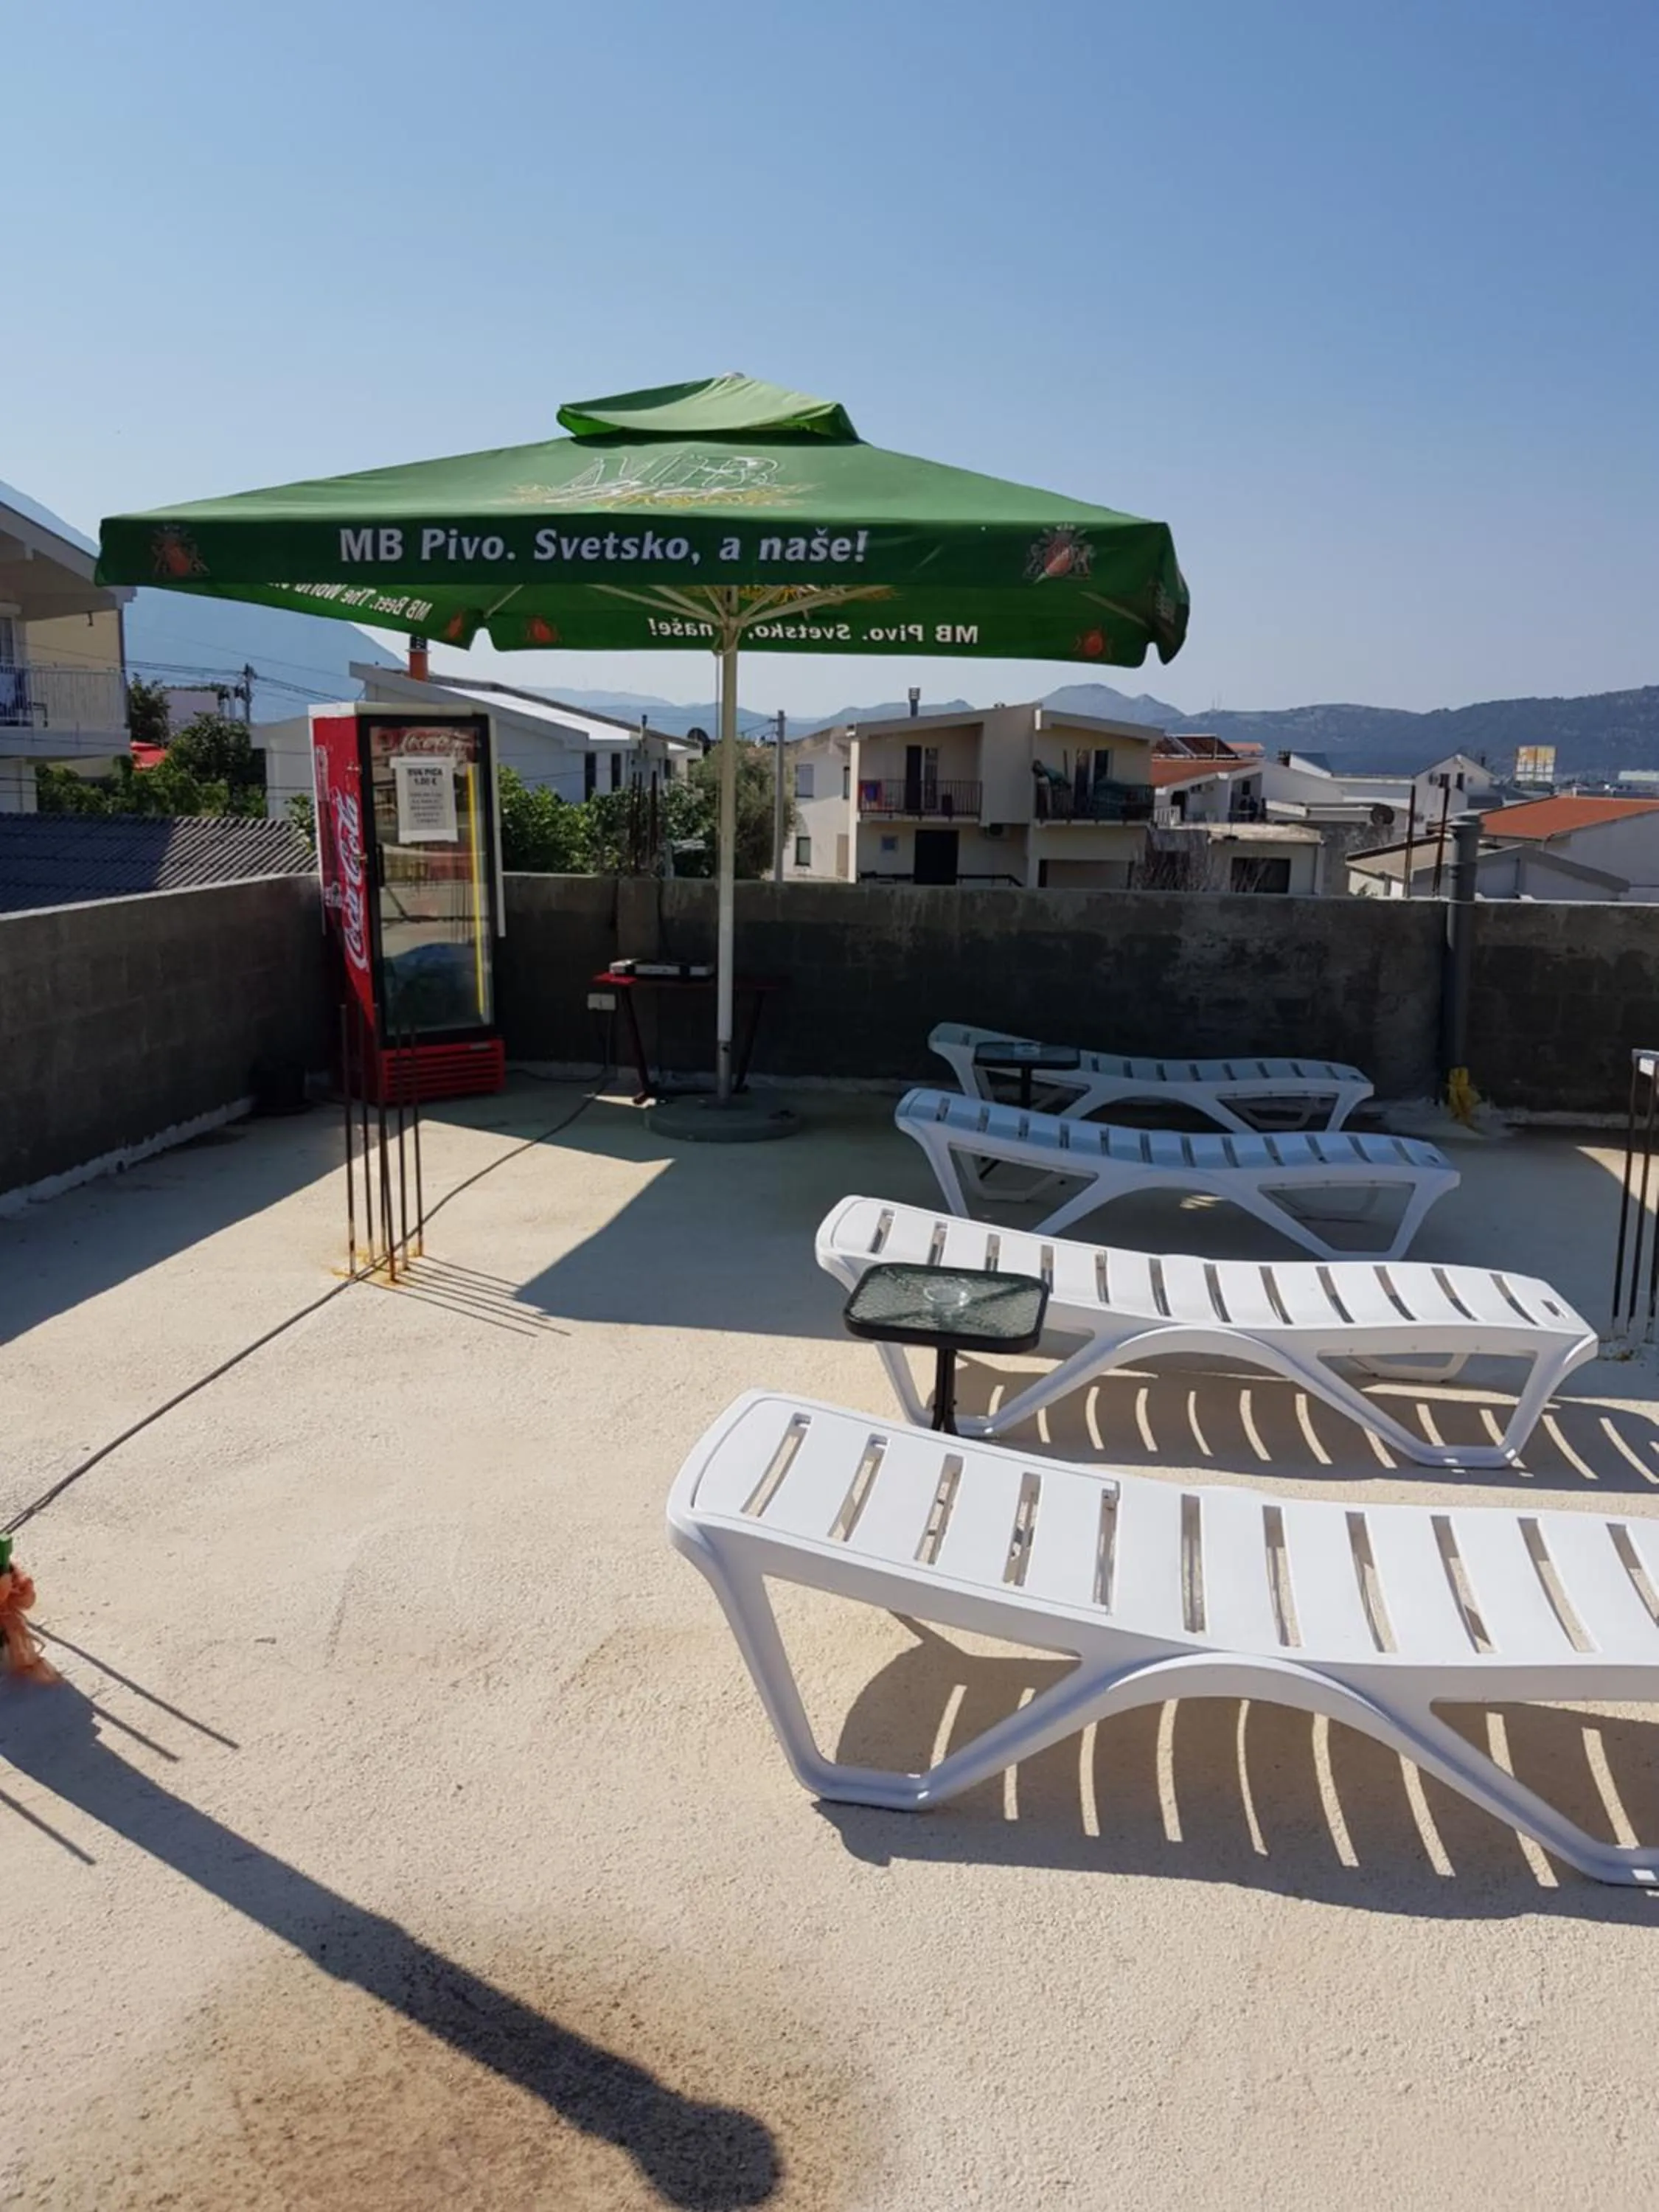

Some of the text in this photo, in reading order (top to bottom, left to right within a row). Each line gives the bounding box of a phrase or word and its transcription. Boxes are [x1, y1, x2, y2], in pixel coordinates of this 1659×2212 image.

[340, 527, 869, 566] MB Pivo. Svetsko, a naše!
